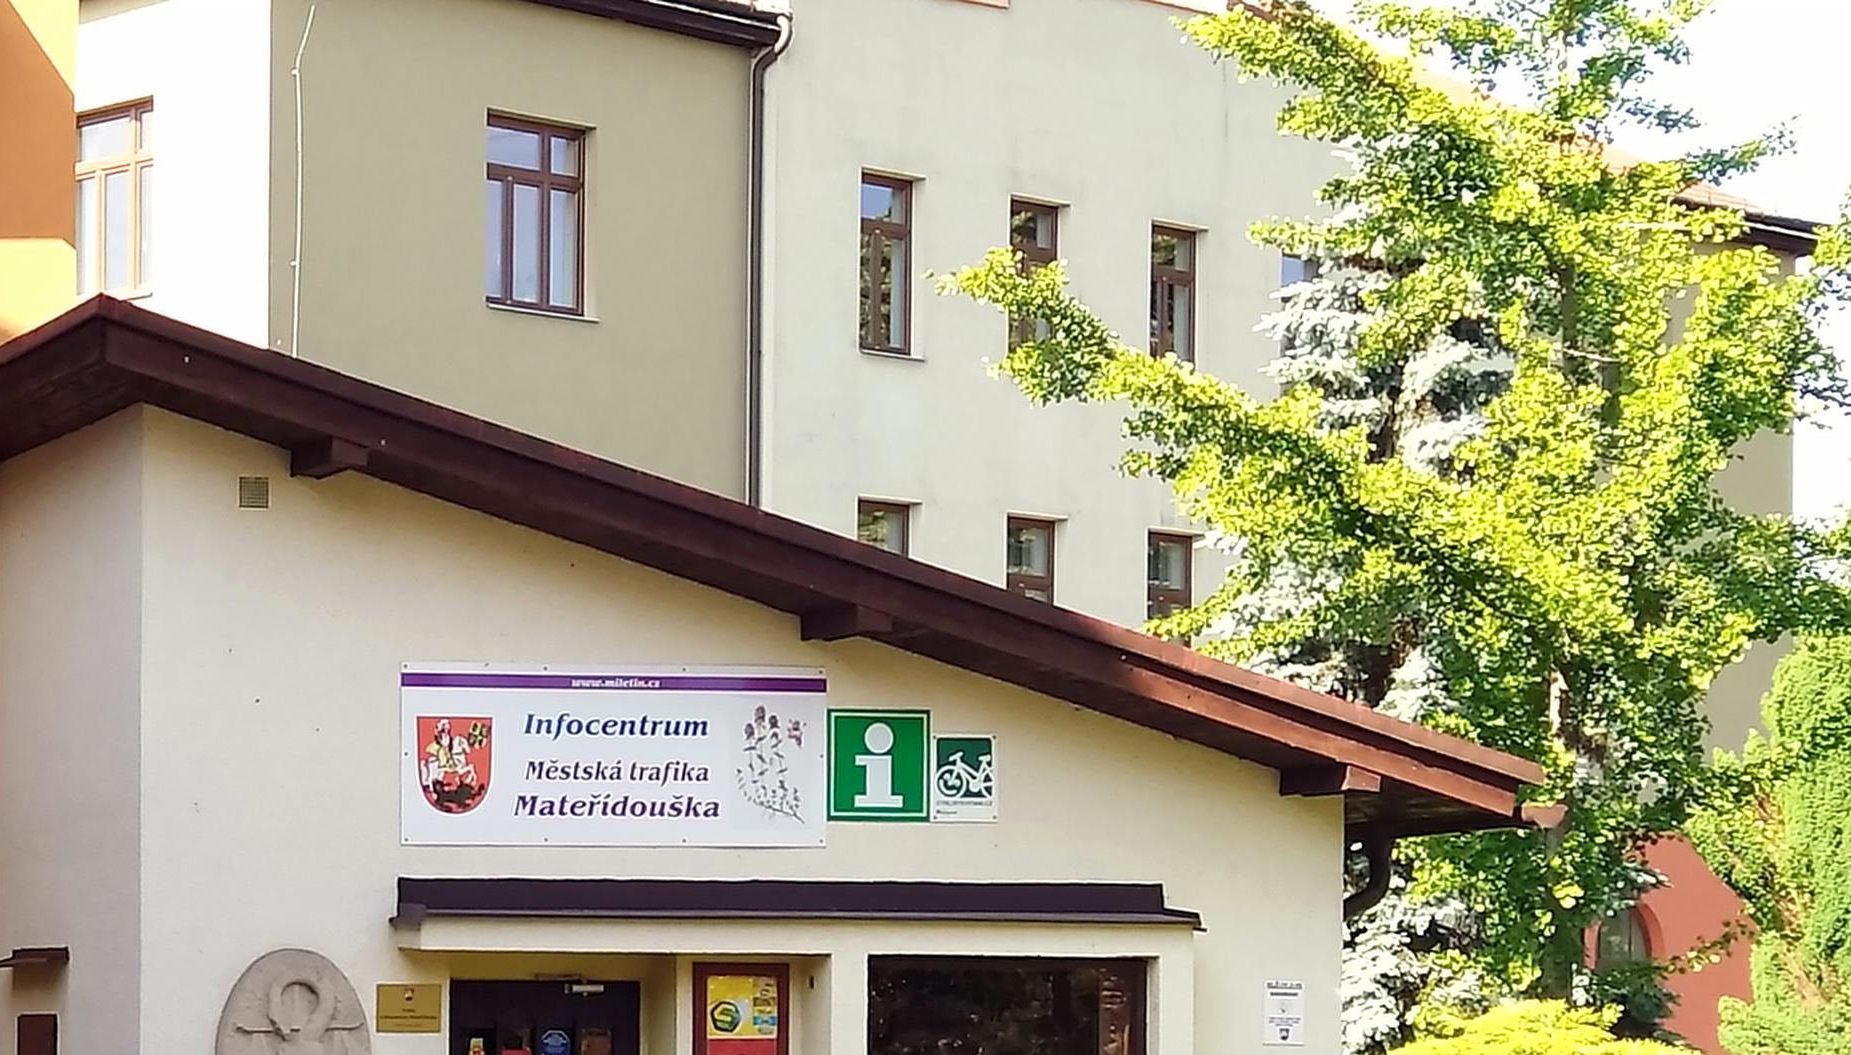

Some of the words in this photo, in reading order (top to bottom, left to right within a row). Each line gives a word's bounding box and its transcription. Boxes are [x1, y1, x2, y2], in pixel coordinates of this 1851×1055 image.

[571, 678, 661, 688] www.miletin.cz
[523, 712, 709, 742] Infocentrum
[525, 758, 623, 782] Městská
[629, 759, 710, 787] trafika
[513, 792, 721, 819] Mateřídouška
